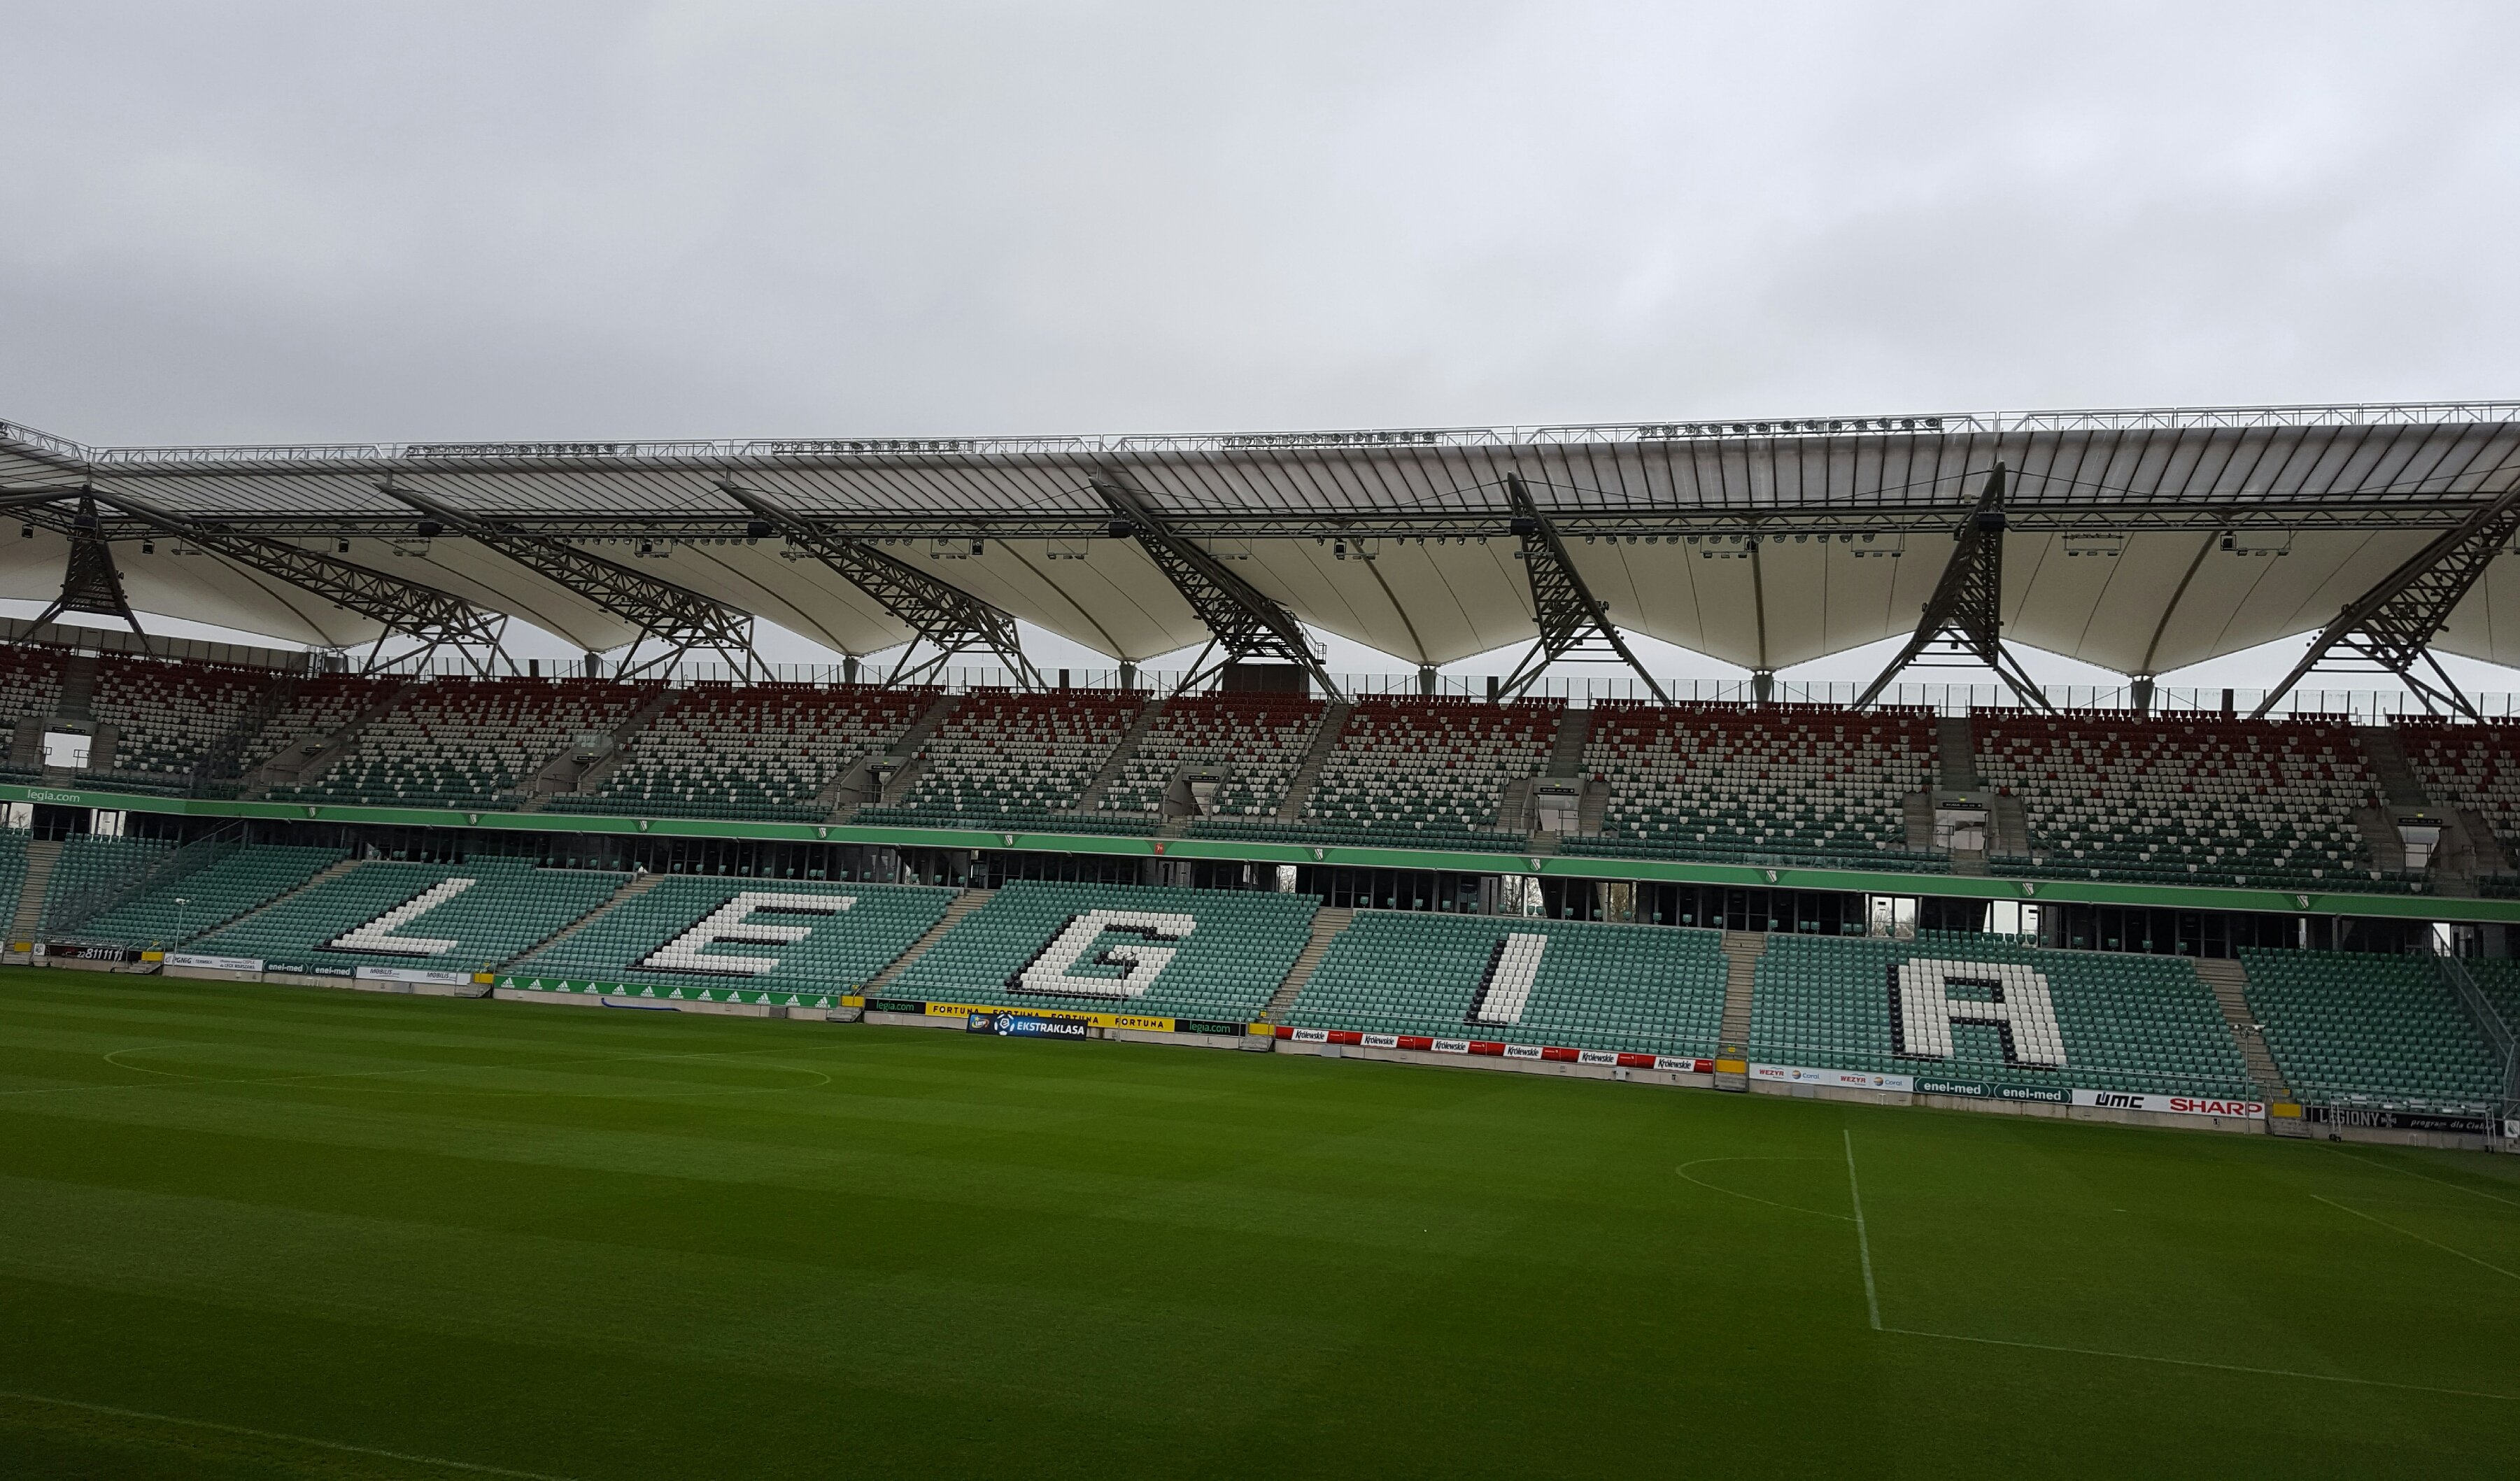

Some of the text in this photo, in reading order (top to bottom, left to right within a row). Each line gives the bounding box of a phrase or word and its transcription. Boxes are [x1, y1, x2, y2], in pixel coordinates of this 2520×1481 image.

[27, 789, 80, 802] legia.com
[268, 963, 303, 972] enel-med
[315, 966, 351, 975] enel-med
[876, 999, 914, 1012] legia.com
[933, 1005, 979, 1014] FORTUNA
[1017, 1021, 1085, 1035] EKSTRAKLASA
[1114, 1018, 1164, 1028] FORTUNA
[1189, 1019, 1231, 1033] legia.com
[1295, 1029, 1325, 1040] Królewskie
[1364, 1035, 1394, 1046] Królewskie
[1435, 1040, 1466, 1051] Królewskie
[1507, 1045, 1539, 1056] Królewskie
[1581, 1051, 1614, 1063] Królewskie
[1658, 1058, 1692, 1070] Królewskie
[1924, 1082, 1981, 1095] enel-med
[2003, 1087, 2061, 1100] enel-med
[2169, 1098, 2263, 1116] SHARP
[2319, 1108, 2379, 1127] LEGIONY
